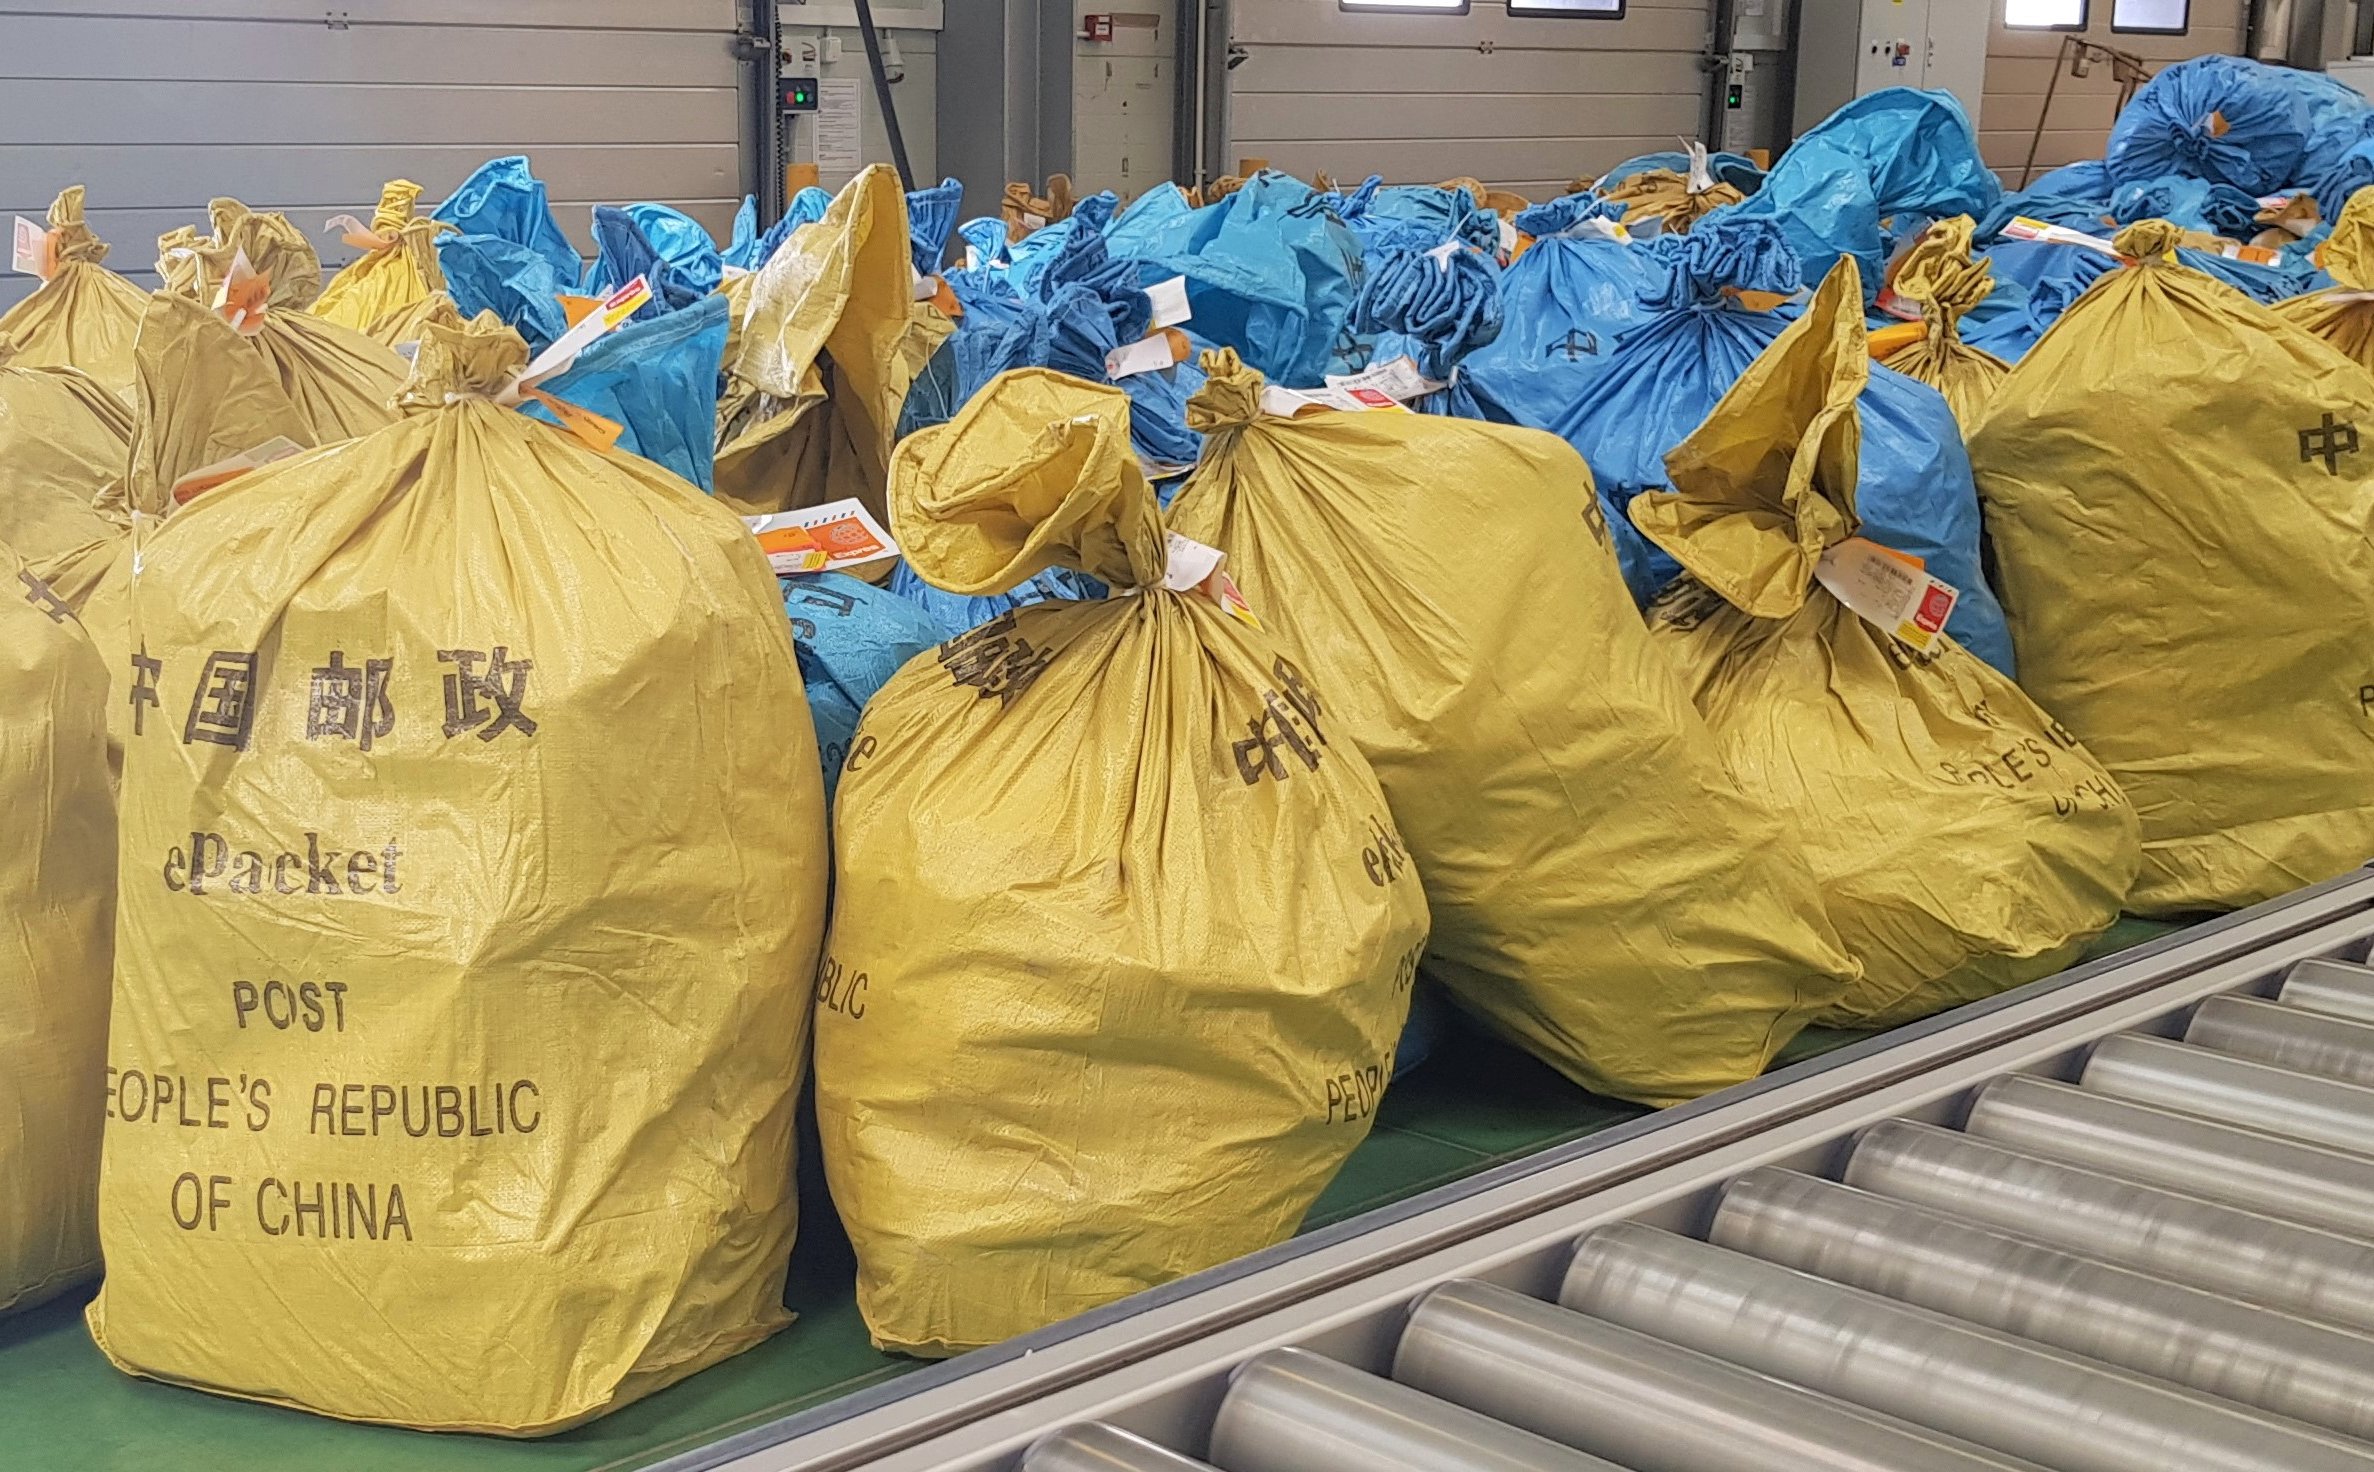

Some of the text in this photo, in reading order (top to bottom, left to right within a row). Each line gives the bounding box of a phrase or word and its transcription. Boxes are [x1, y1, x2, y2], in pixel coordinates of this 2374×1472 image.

[2299, 412, 2359, 476] 中
[164, 832, 403, 896] ePacket
[233, 980, 348, 1032] POST
[816, 953, 868, 1020] BLIC
[310, 1079, 541, 1137] REPUBLIC
[171, 1171, 413, 1241] OF CHINA
